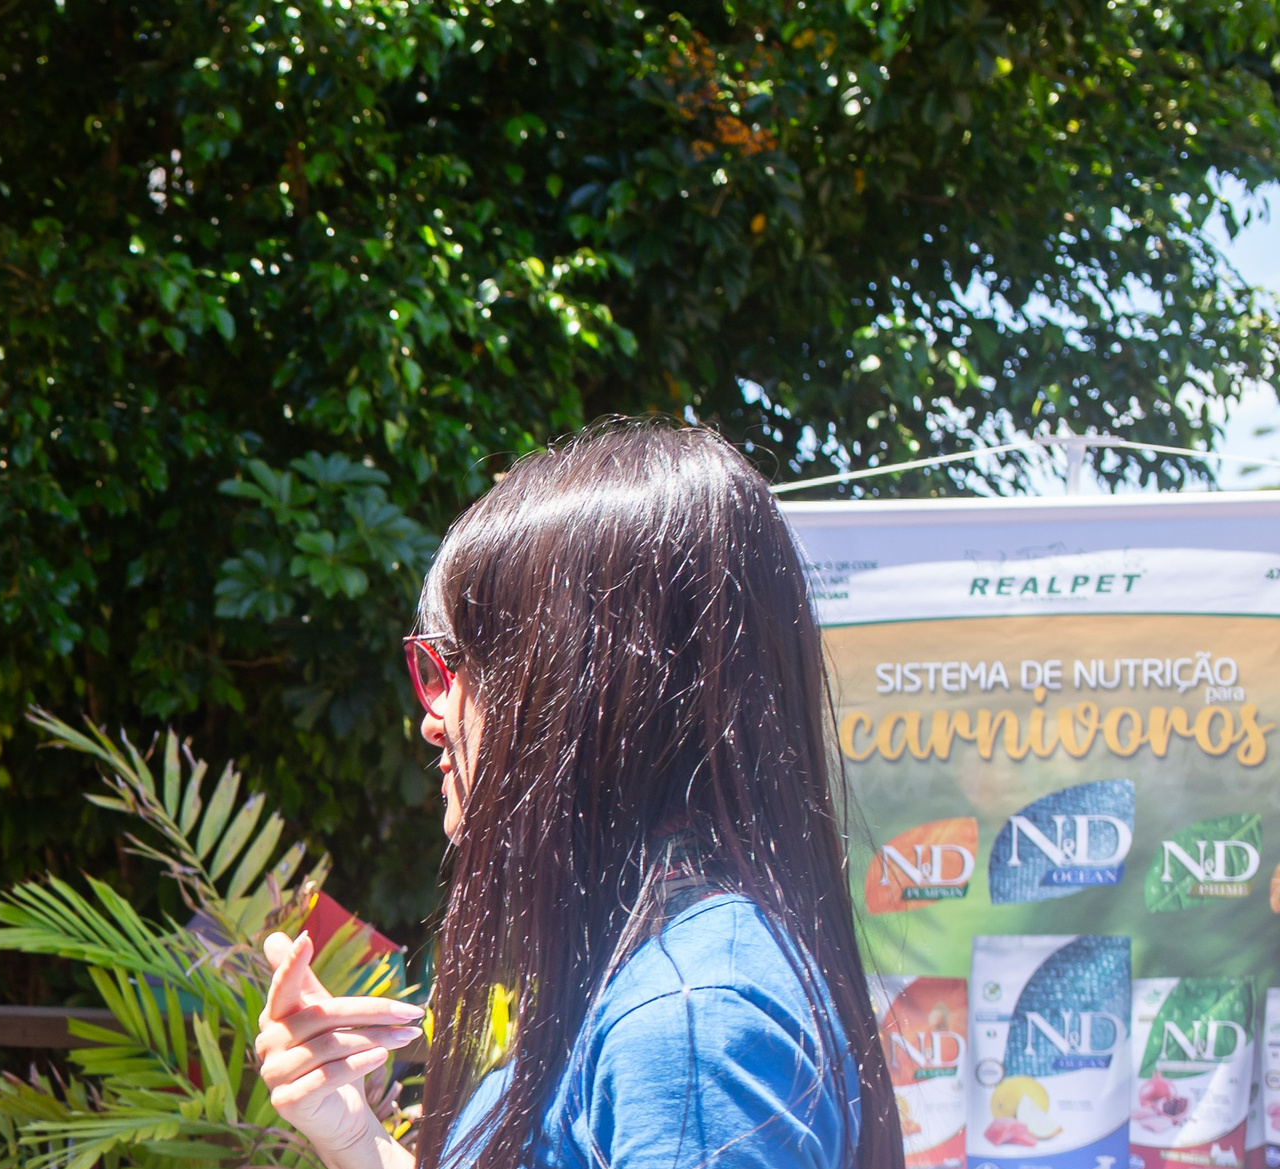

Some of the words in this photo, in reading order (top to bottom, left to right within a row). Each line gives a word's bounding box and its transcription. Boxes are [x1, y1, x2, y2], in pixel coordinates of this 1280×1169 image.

[969, 574, 1141, 595] REALPET
[875, 661, 1009, 693] SISTEMA
[1020, 659, 1063, 691] DE
[1073, 652, 1237, 693] NUTRIÇÃO
[1205, 685, 1245, 704] para
[1007, 814, 1132, 868] N&D
[1161, 840, 1260, 883] N&D
[880, 844, 975, 886] N&D
[1024, 1011, 1127, 1056] N&D
[1159, 1020, 1246, 1062] N&D
